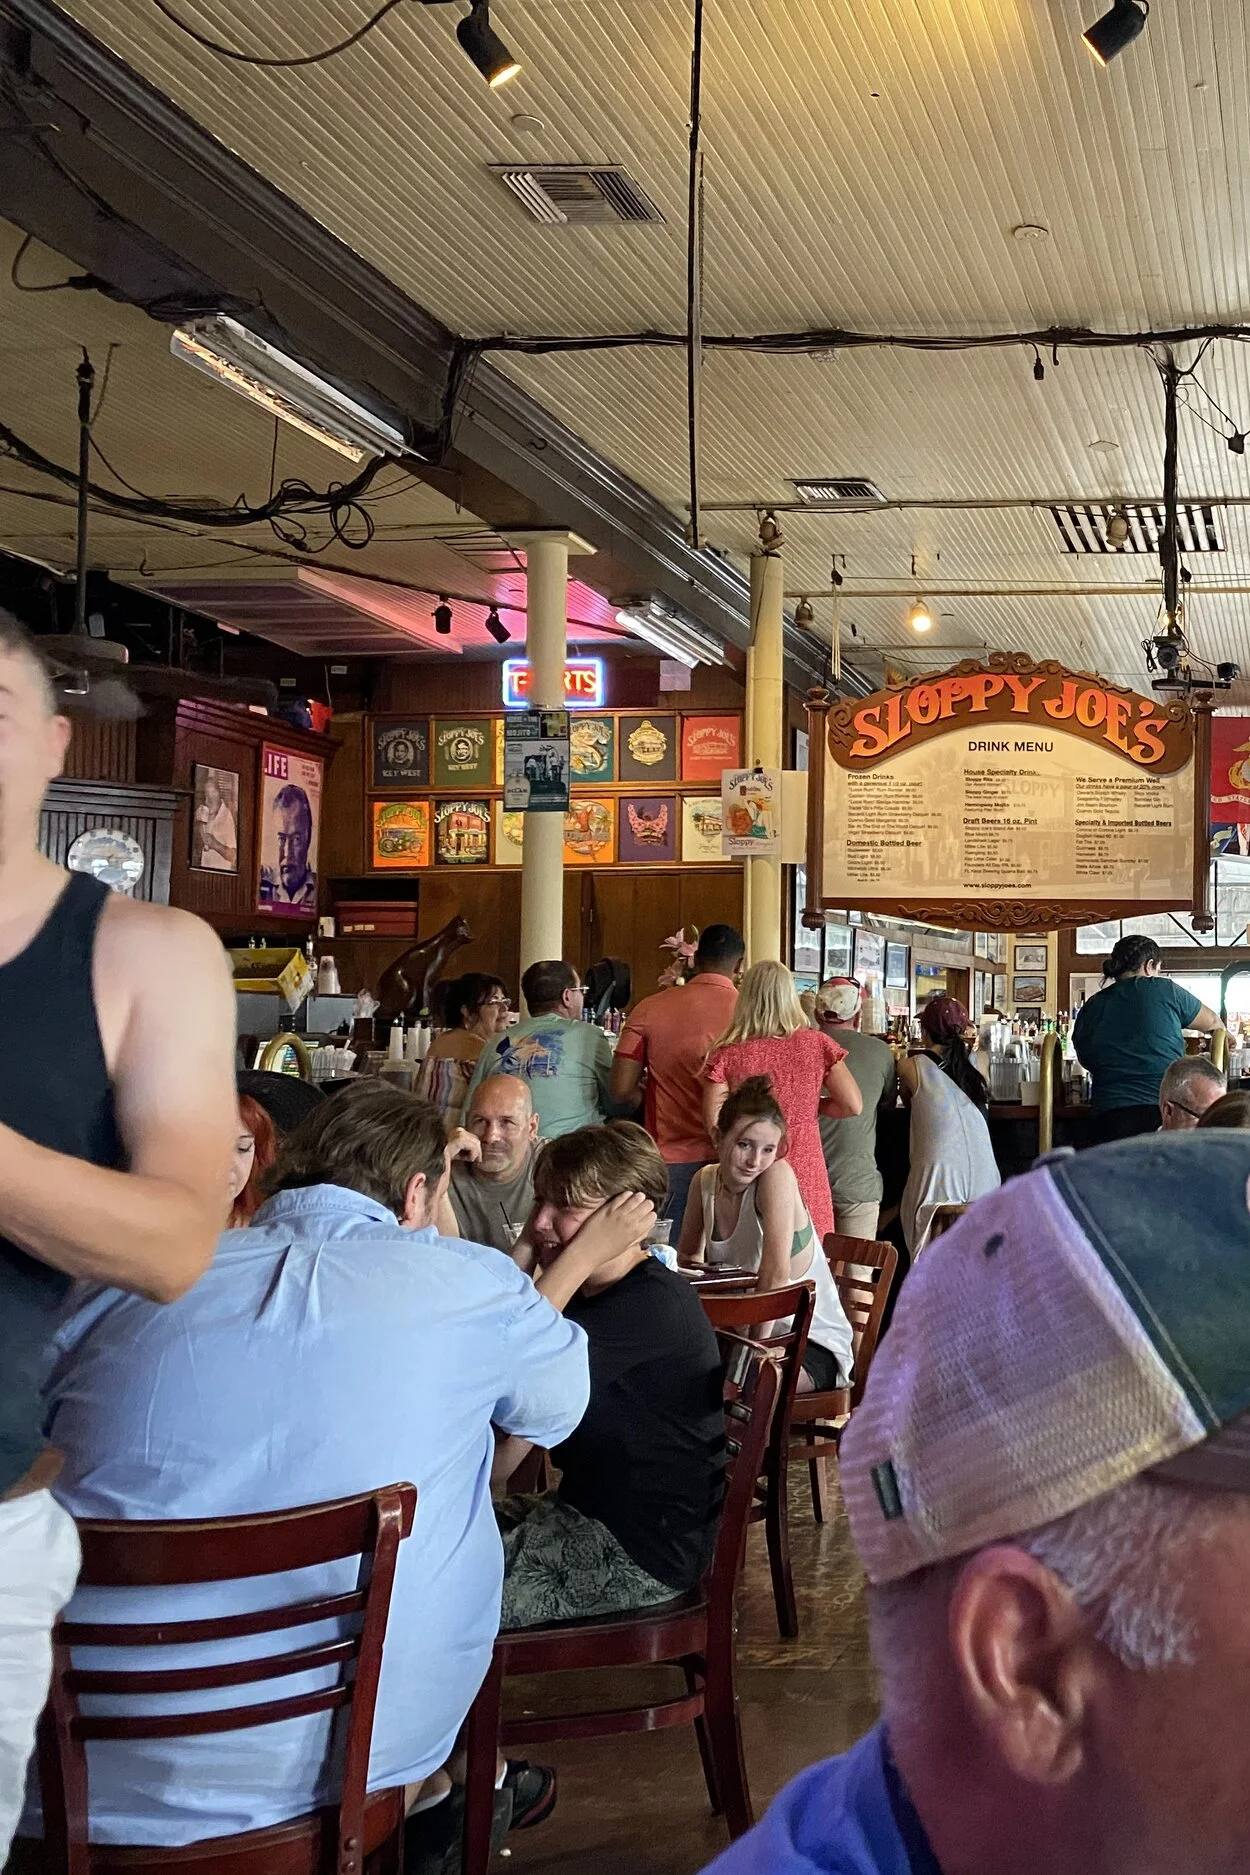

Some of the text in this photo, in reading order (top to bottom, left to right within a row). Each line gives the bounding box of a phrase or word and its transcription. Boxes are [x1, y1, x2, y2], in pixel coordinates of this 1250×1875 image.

[850, 673, 1171, 764] SLOPPY JOE'S
[378, 727, 406, 749] SLOPPY
[438, 727, 485, 746] SLOPPY JOE'S
[687, 726, 717, 747] SLOPPY
[968, 741, 1054, 752] DRINK MENU
[264, 754, 288, 778] IFE
[400, 769, 421, 777] WEST
[434, 801, 491, 824] SLOPPY JOE'S
[1075, 819, 1101, 827] Specialty
[1102, 819, 1107, 827] &
[1107, 819, 1134, 827] Imported
[1155, 819, 1172, 827] Beers
[728, 837, 755, 847] Sloppy
[846, 839, 922, 847] Domestic Bottled Beer
